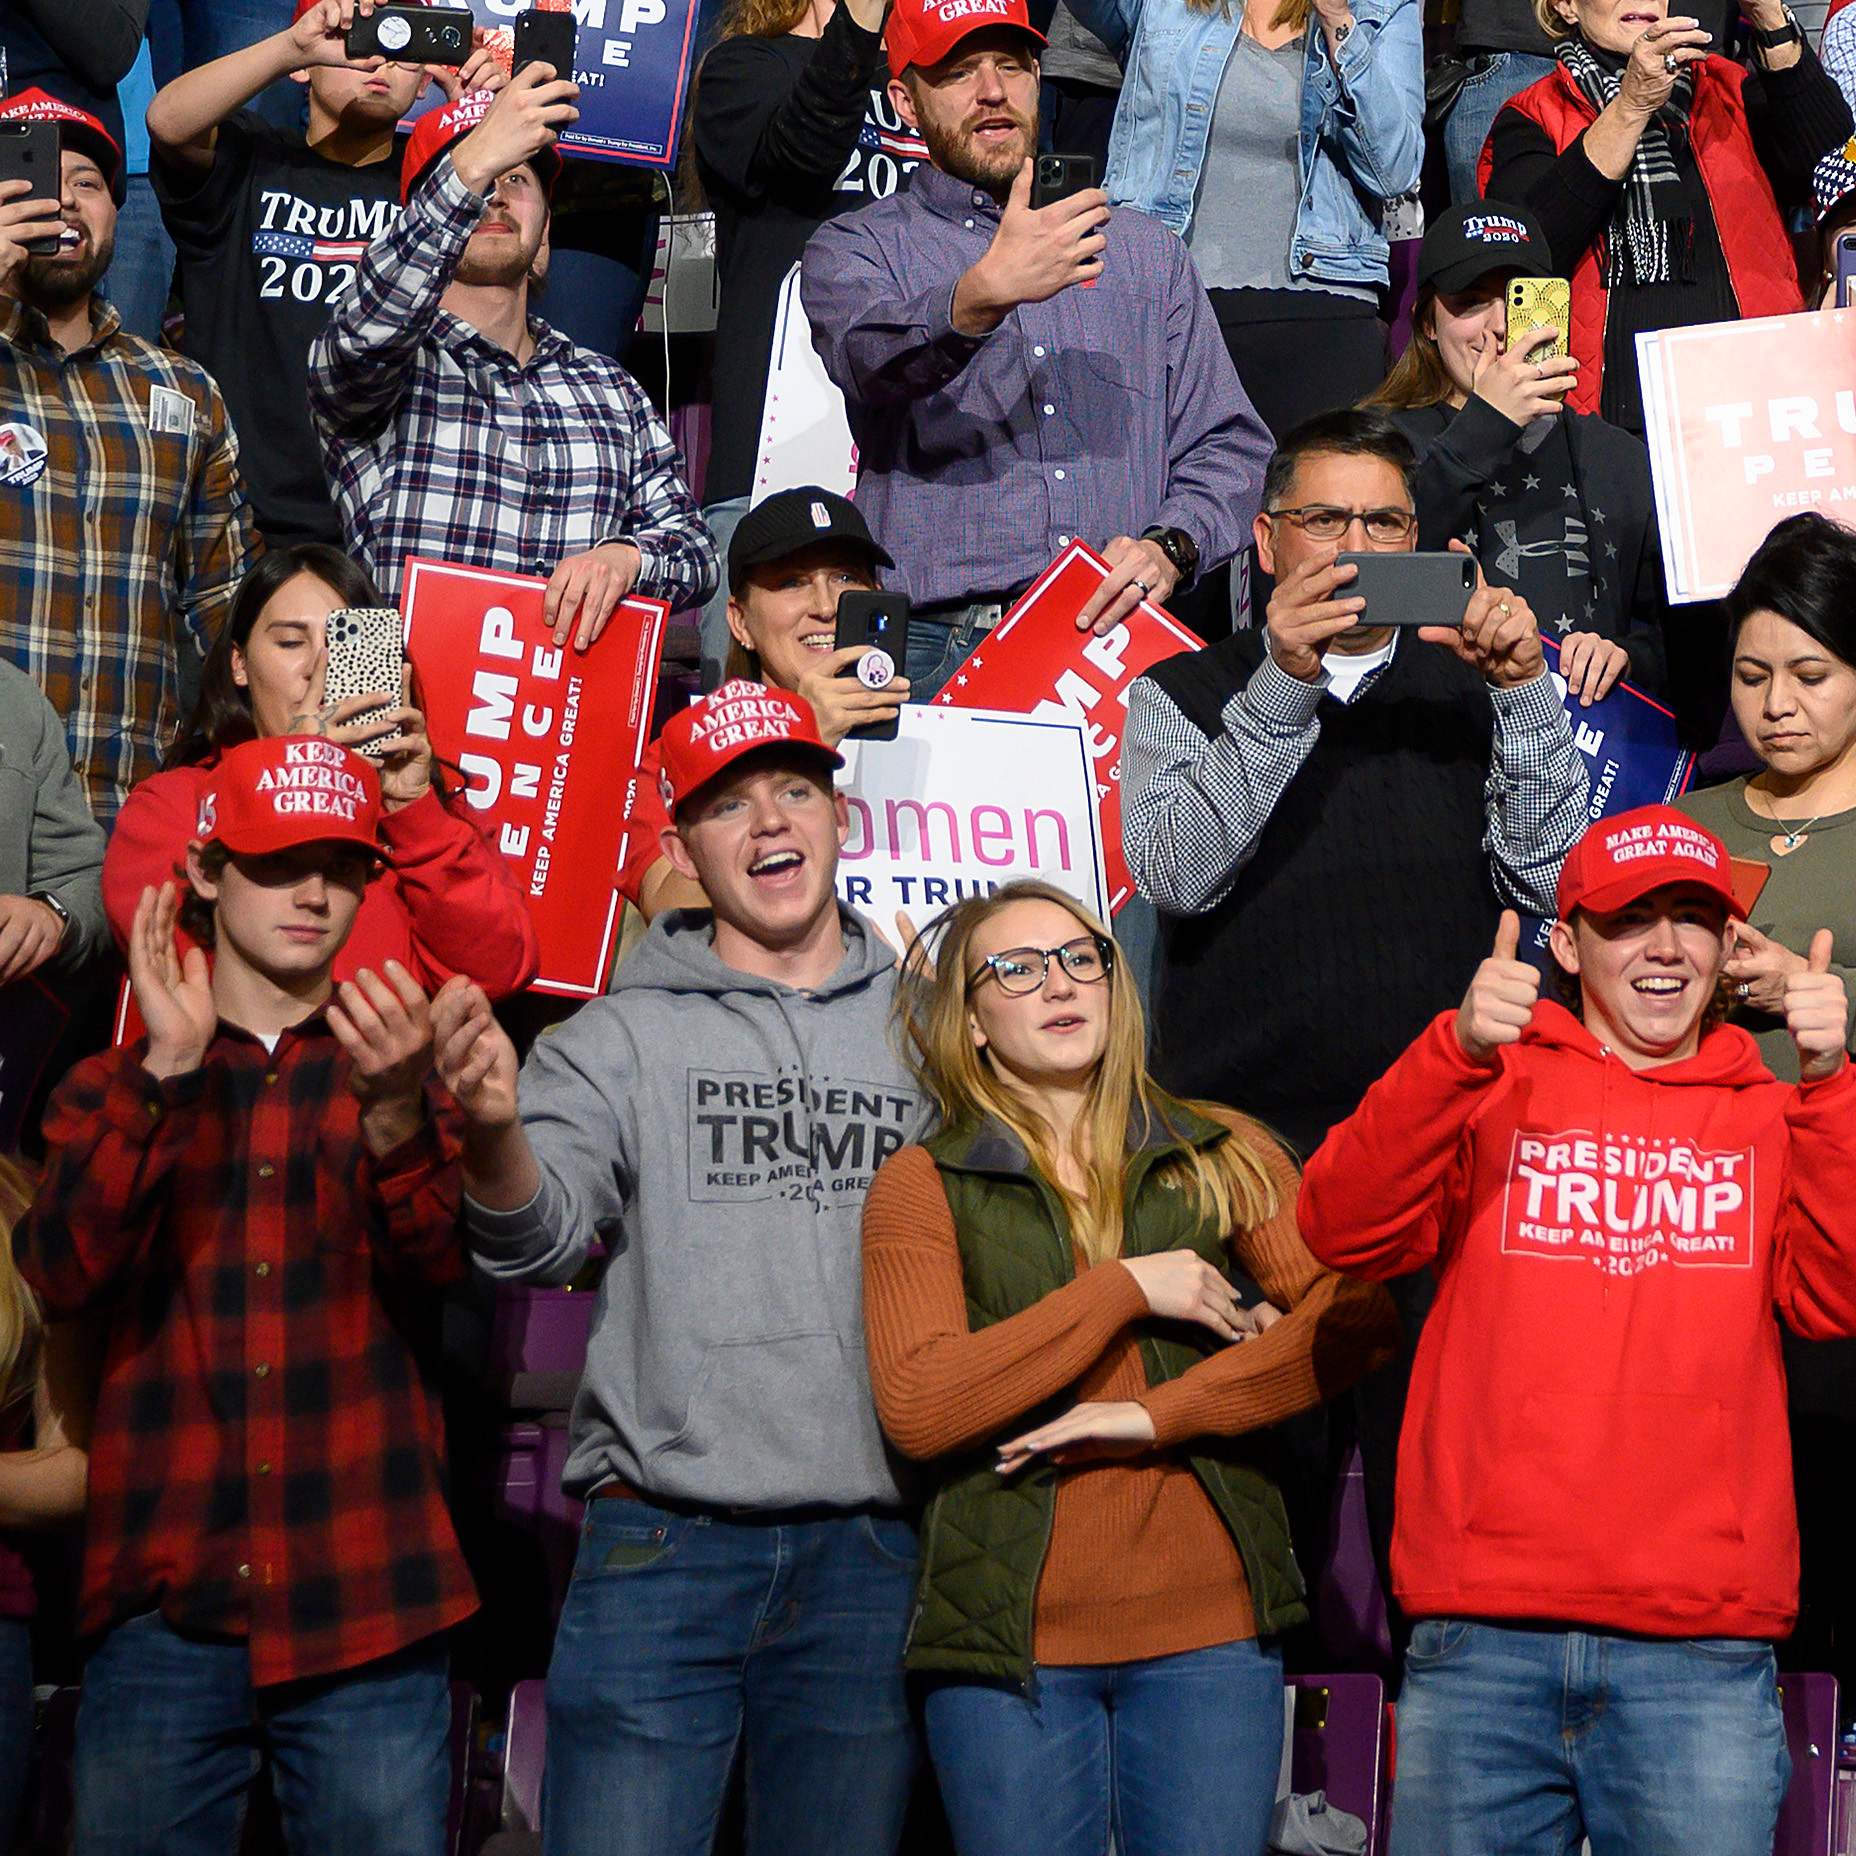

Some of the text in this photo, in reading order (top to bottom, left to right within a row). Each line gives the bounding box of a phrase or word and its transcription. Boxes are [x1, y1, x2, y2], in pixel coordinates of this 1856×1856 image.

[1463, 216, 1528, 236] Trump
[1483, 231, 1519, 245] 2020
[9, 460, 45, 483] TRUMP
[1773, 490, 1820, 508] KEEP
[708, 680, 765, 704] KEEP
[690, 700, 801, 742] AMERICA
[711, 718, 790, 751] GREAT
[284, 742, 348, 768] KEEP
[255, 762, 370, 805] AMERICA
[530, 676, 587, 900] KEEP AMERICA GREAT!
[272, 790, 360, 823] GREAT
[1605, 823, 1718, 855] MAKE AMERICA
[1612, 839, 1718, 869] GREAT AGAIN
[698, 1076, 915, 1119] PRESIDENT
[697, 1113, 906, 1176] TRUMP
[1518, 1139, 1746, 1185] PRESIDENT
[705, 1169, 763, 1190] KEEP
[1520, 1173, 1745, 1235] TRUMP
[1519, 1222, 1575, 1243] KEEP
